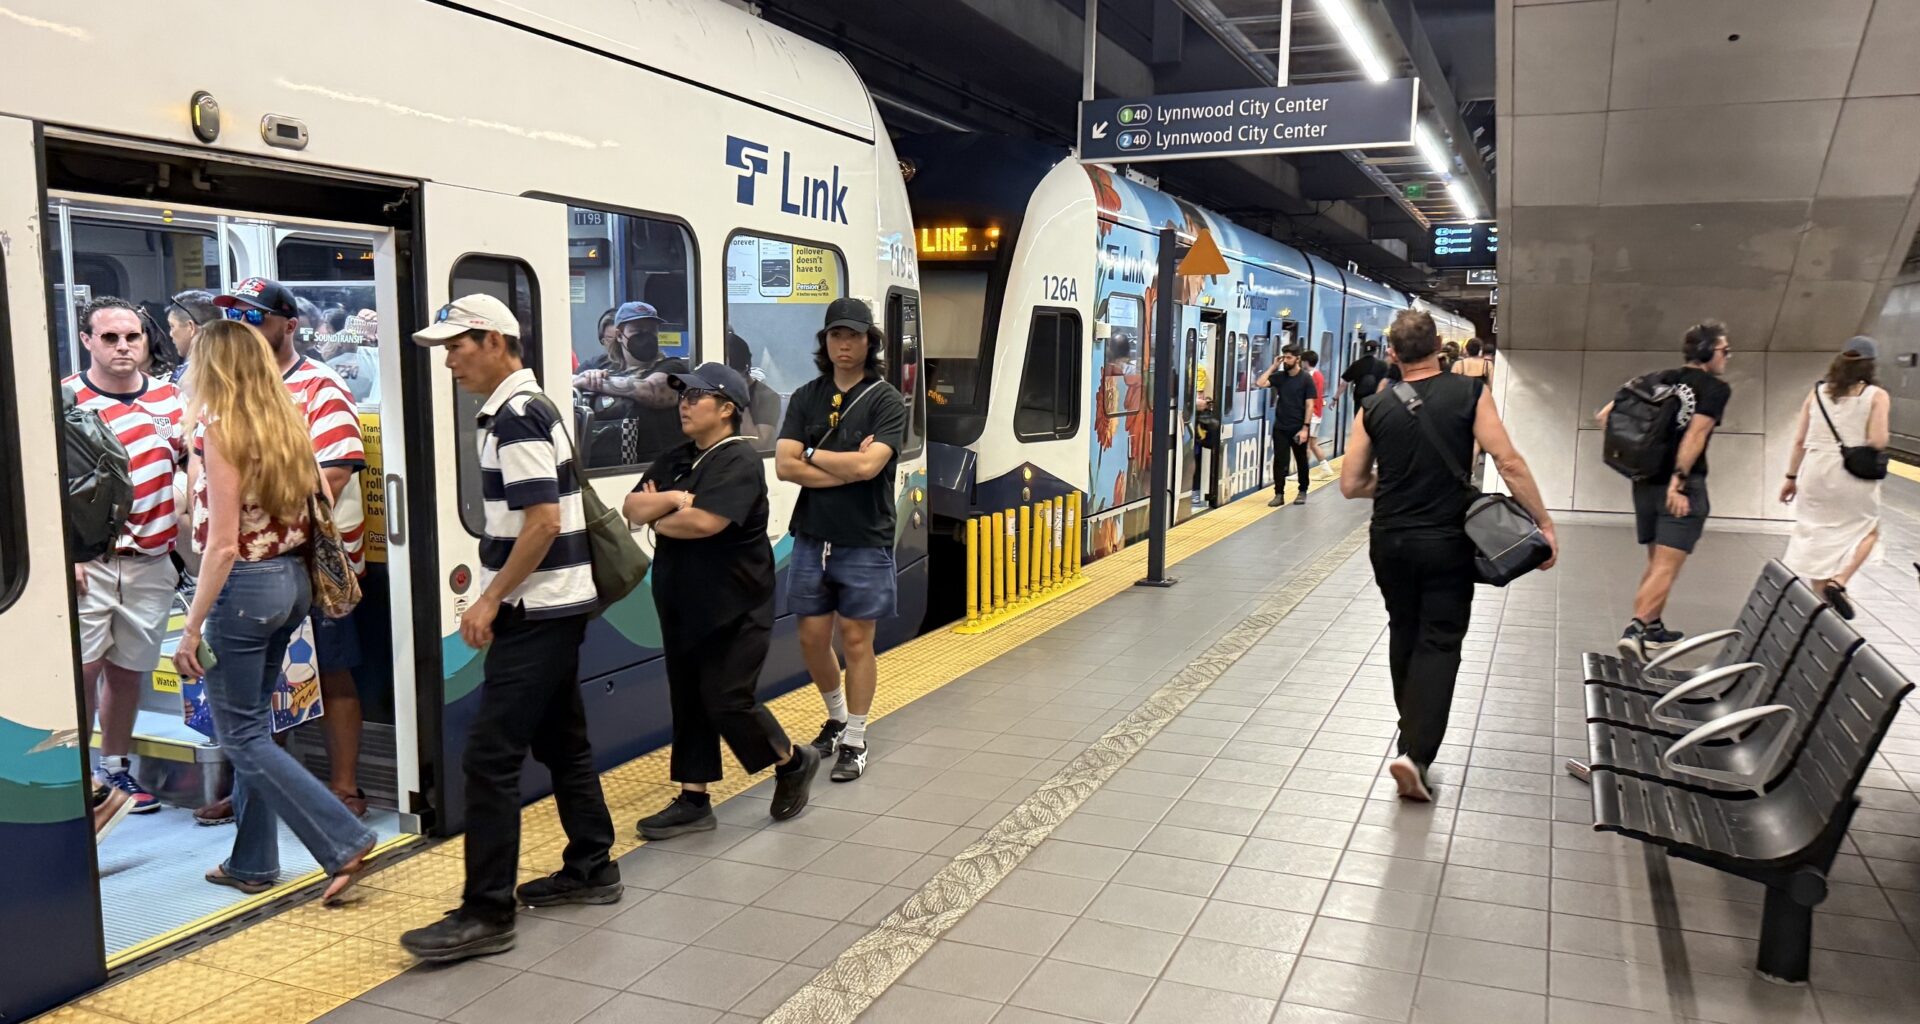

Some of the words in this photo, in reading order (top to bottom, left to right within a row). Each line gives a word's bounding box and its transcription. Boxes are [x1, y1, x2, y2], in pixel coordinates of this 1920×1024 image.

[1134, 109, 1148, 120] 40
[1157, 100, 1234, 125] Lynnwood
[1239, 99, 1270, 119] City
[1274, 97, 1329, 114] Center
[1133, 135, 1147, 145] 40
[1156, 126, 1233, 150] Lynnwood
[1238, 125, 1269, 144] City
[1273, 123, 1328, 139] Center
[781, 151, 849, 225] Link
[576, 213, 602, 225] 119B
[796, 256, 823, 264] doesn't
[1121, 245, 1145, 285] Link
[1043, 275, 1078, 302] 126A
[156, 677, 177, 687] Watch
